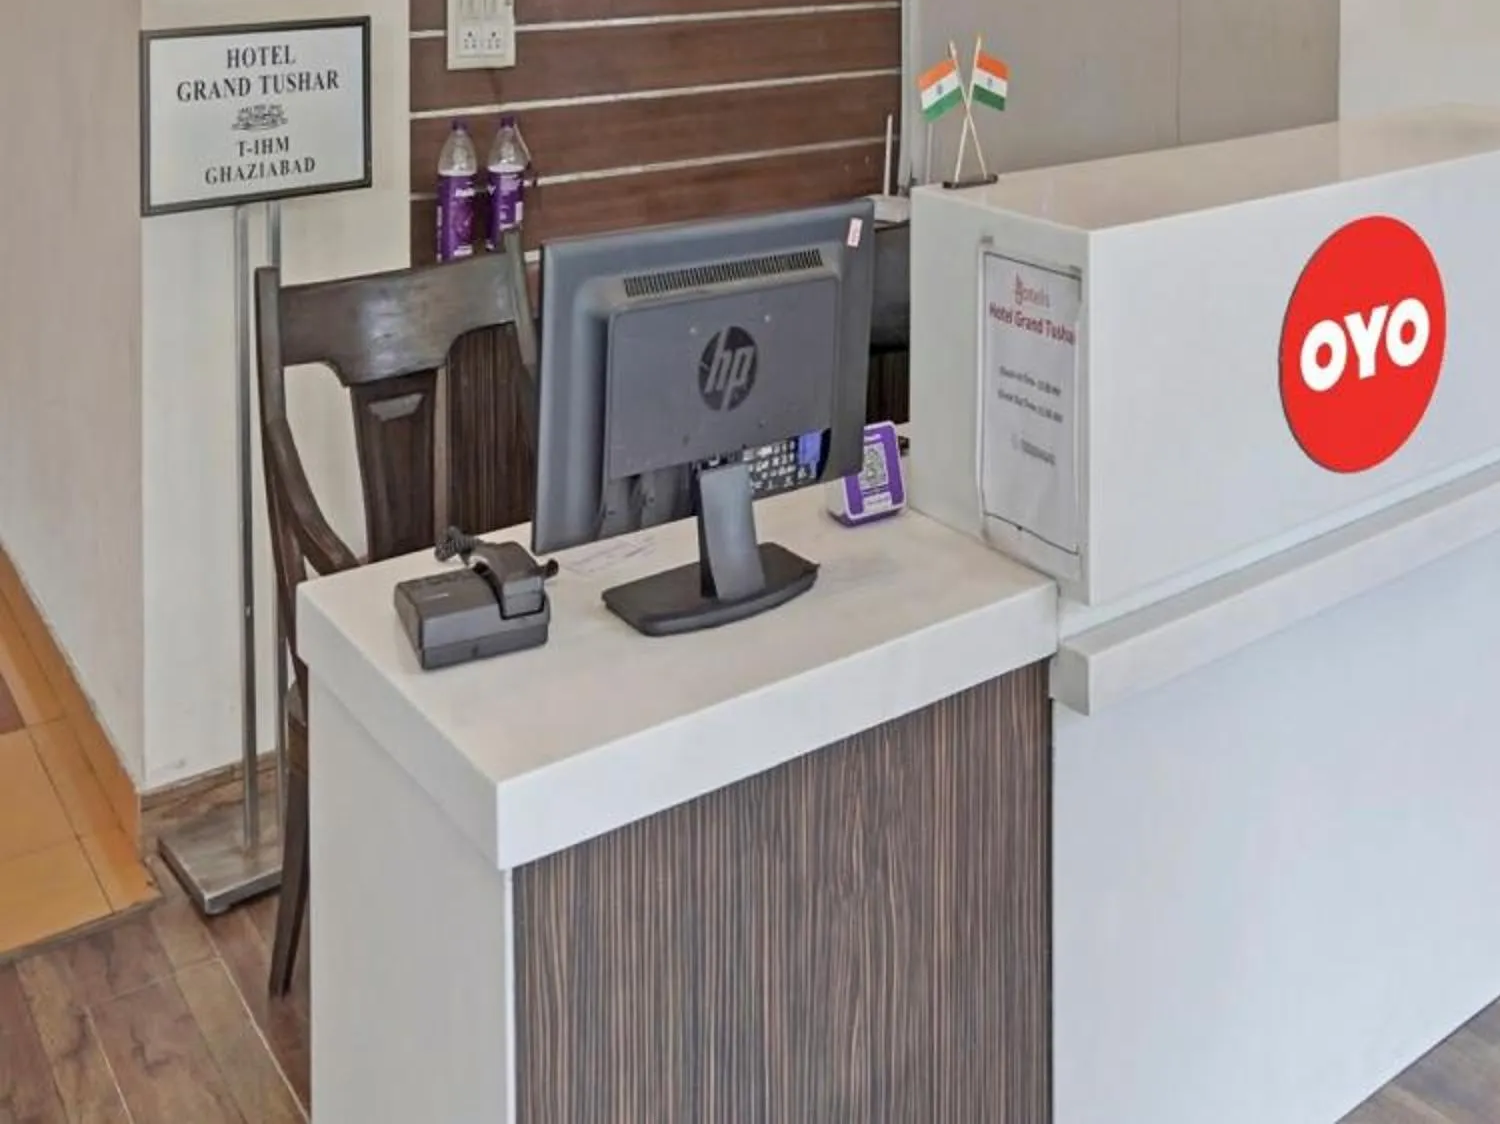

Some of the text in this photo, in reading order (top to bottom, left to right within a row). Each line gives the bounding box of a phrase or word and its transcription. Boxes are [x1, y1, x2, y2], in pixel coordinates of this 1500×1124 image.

[226, 44, 296, 69] HOTEL
[176, 70, 340, 102] GRAND TUSHAR
[238, 136, 290, 157] T-IHM
[205, 156, 316, 185] GHAZIABAD
[989, 301, 1013, 325] Hotel
[1014, 309, 1043, 335] Grand
[1300, 297, 1430, 392] OYO
[704, 328, 755, 411] hp
